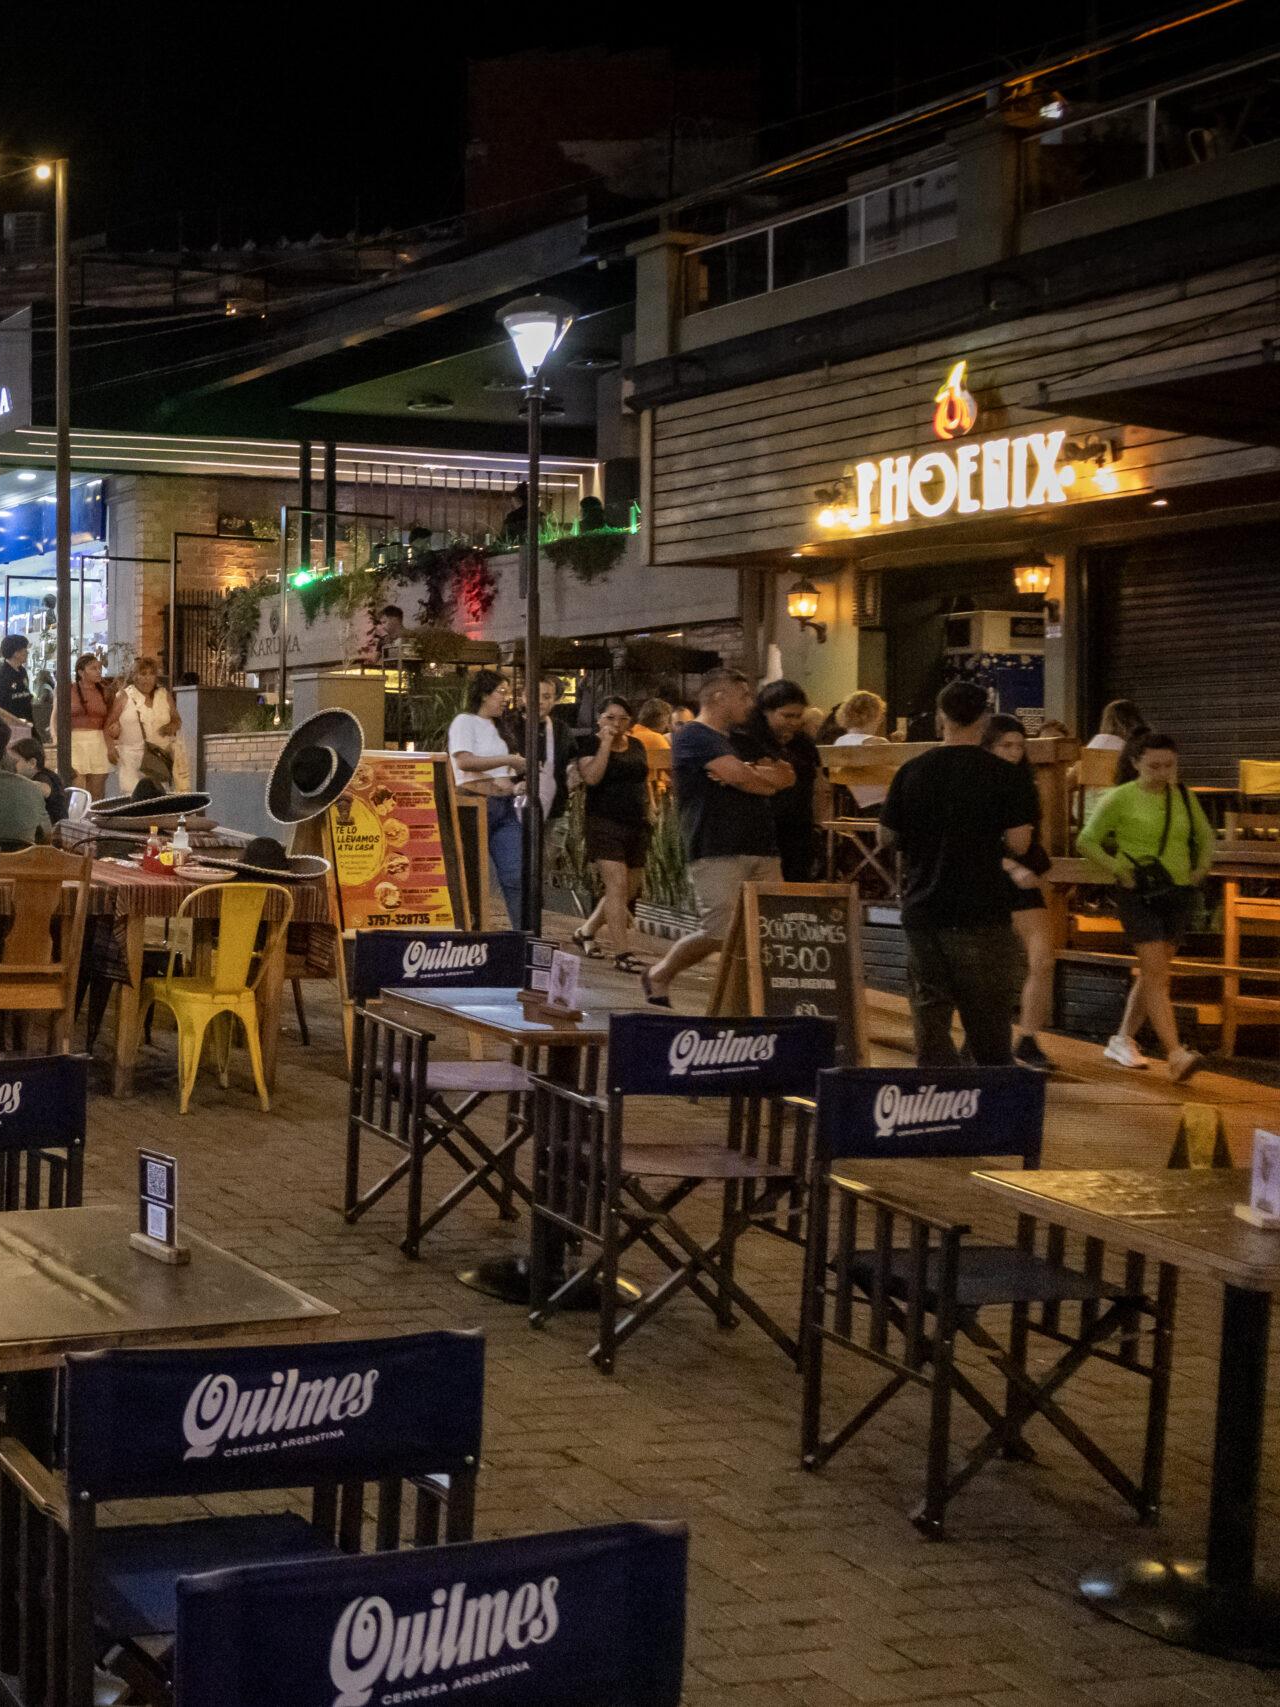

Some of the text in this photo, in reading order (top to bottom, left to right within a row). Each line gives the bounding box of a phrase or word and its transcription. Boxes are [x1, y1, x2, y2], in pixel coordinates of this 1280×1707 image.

[851, 430, 1067, 529] PHOENIX
[336, 826, 357, 834] TE LO
[337, 835, 380, 843] LLEVAMOS
[402, 940, 488, 979] Quilmes
[669, 1029, 777, 1076] Quilmes
[874, 1084, 981, 1138] Quilmes
[182, 1369, 379, 1462] Quilmes
[223, 1429, 345, 1457] CERVEZA ARGENTINA
[328, 1576, 560, 1707] Quilmes
[381, 1661, 530, 1706] CERVEZA ARGENTINA
